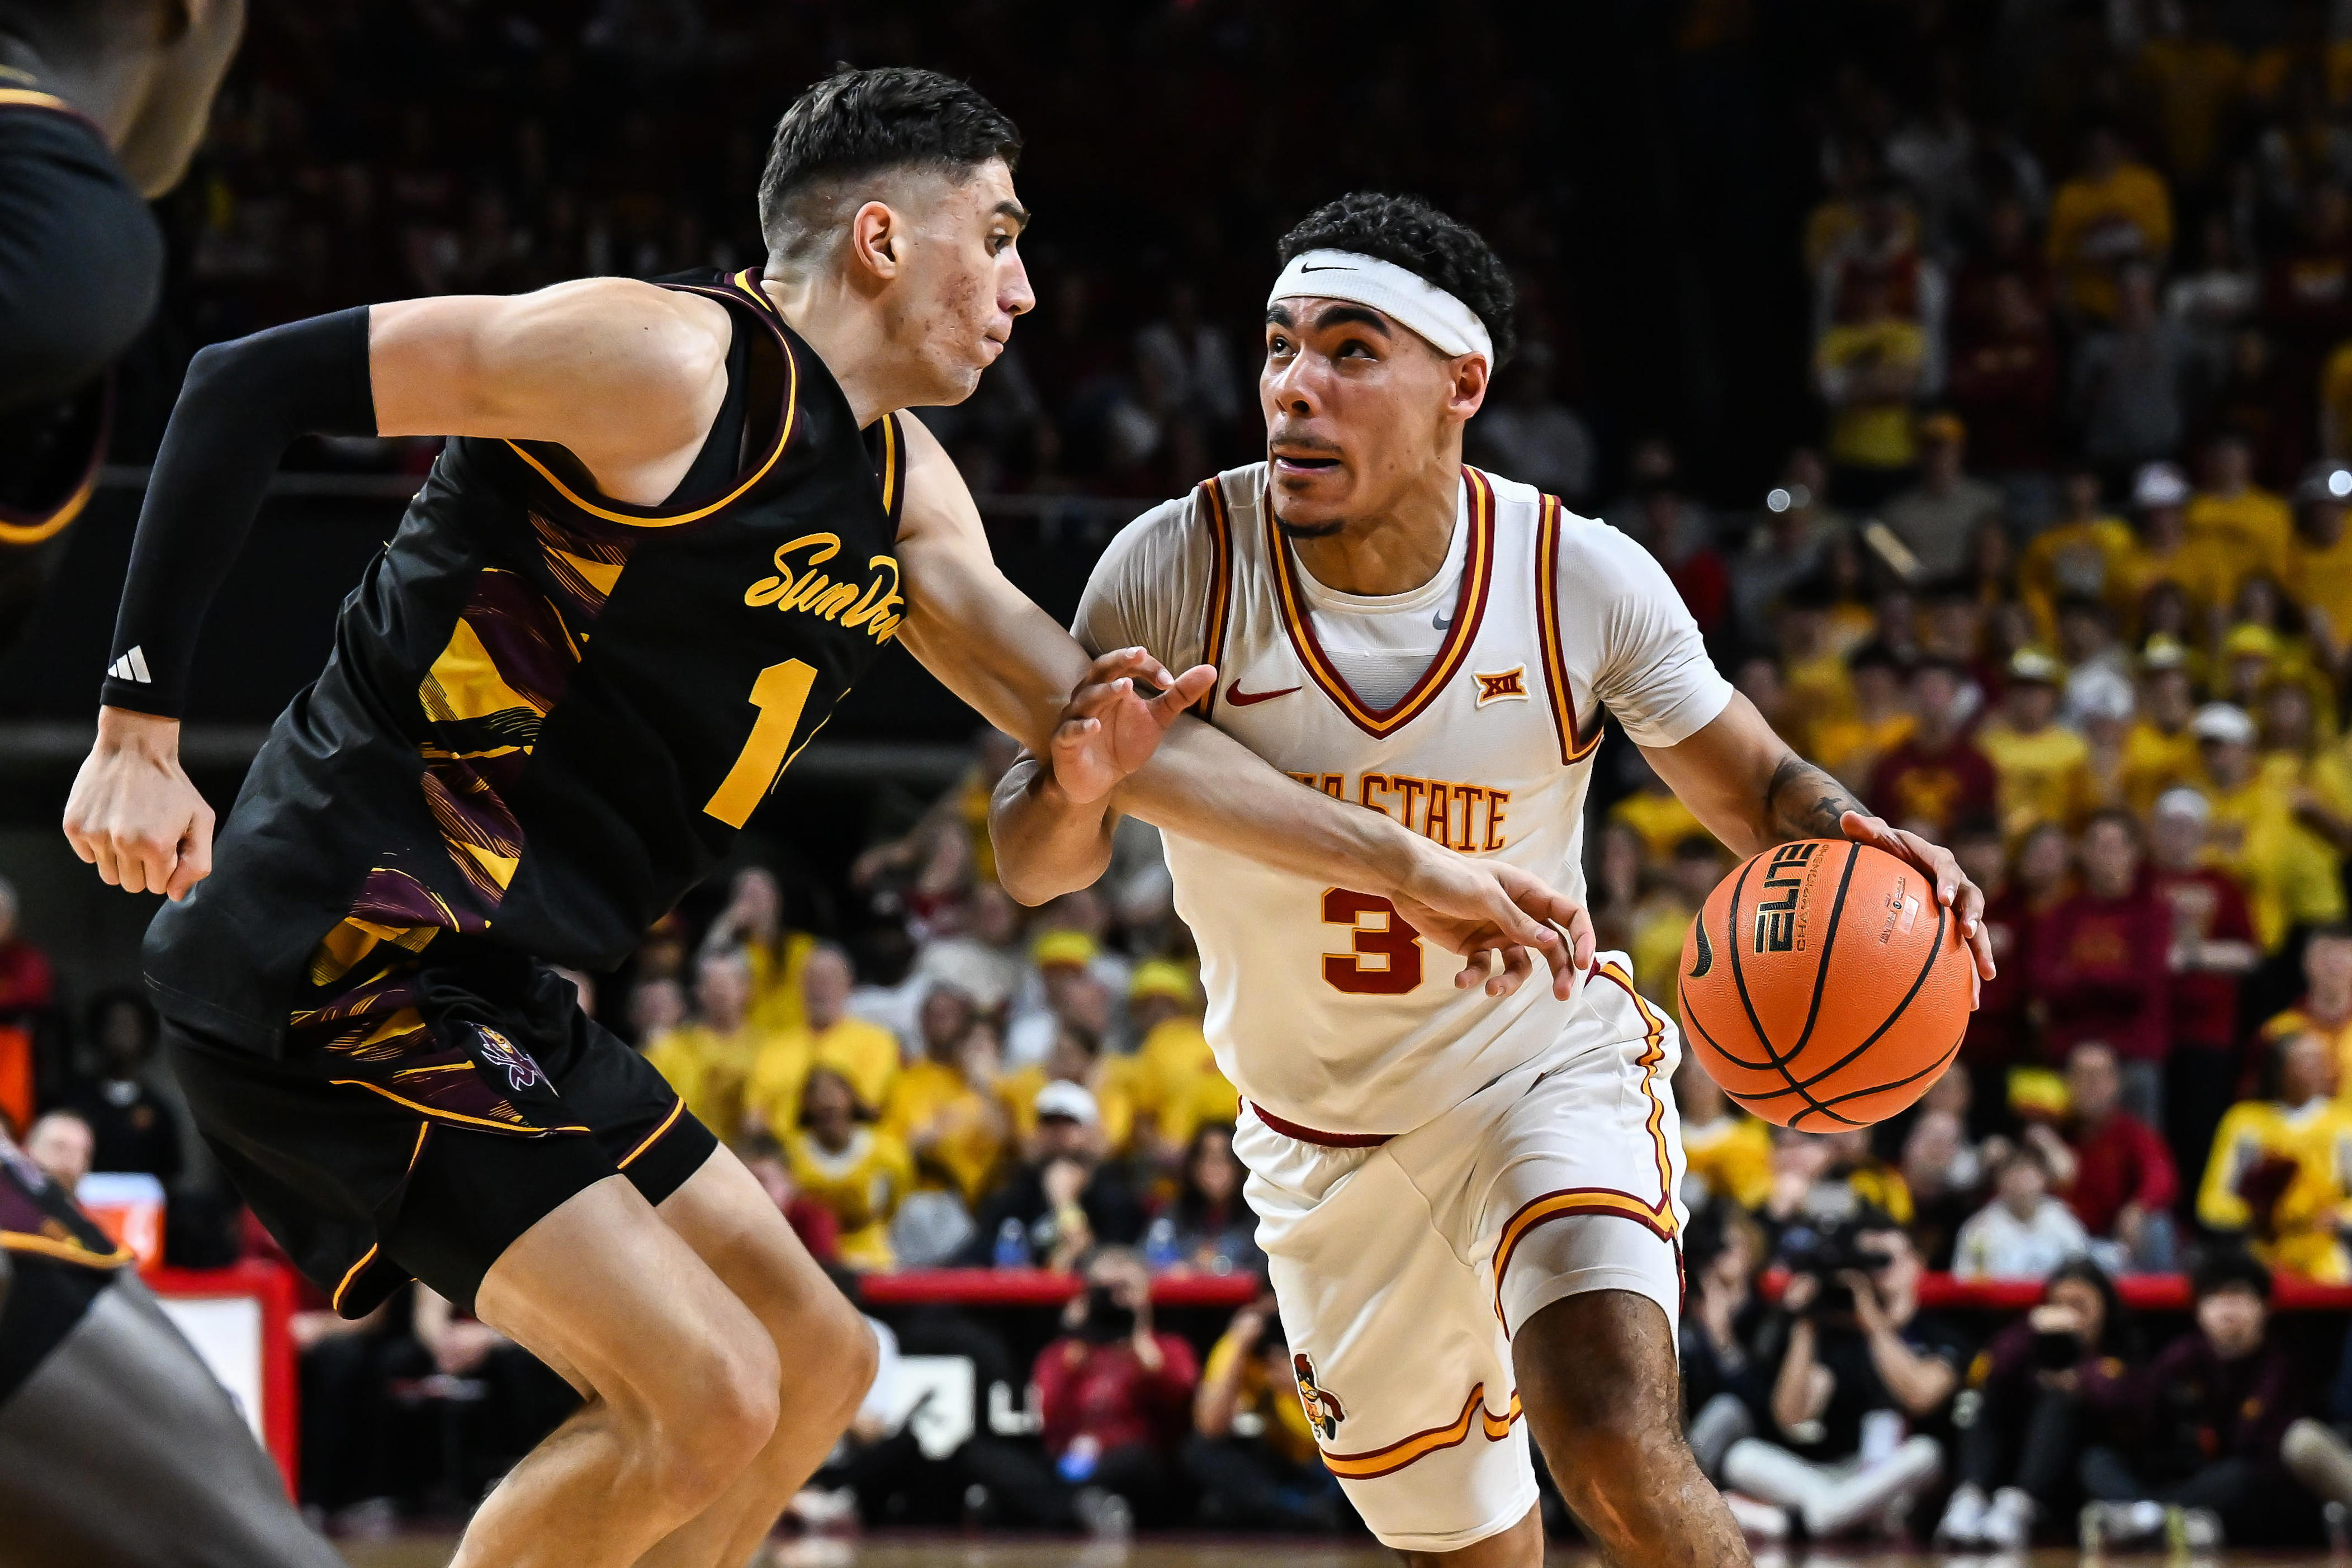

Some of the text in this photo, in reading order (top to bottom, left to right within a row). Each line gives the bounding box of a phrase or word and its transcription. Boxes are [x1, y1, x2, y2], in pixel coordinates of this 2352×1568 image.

[1476, 666, 1526, 703] XII
[702, 657, 818, 830] 1
[1321, 885, 1424, 996] 3
[1753, 842, 1819, 955] ELITE
